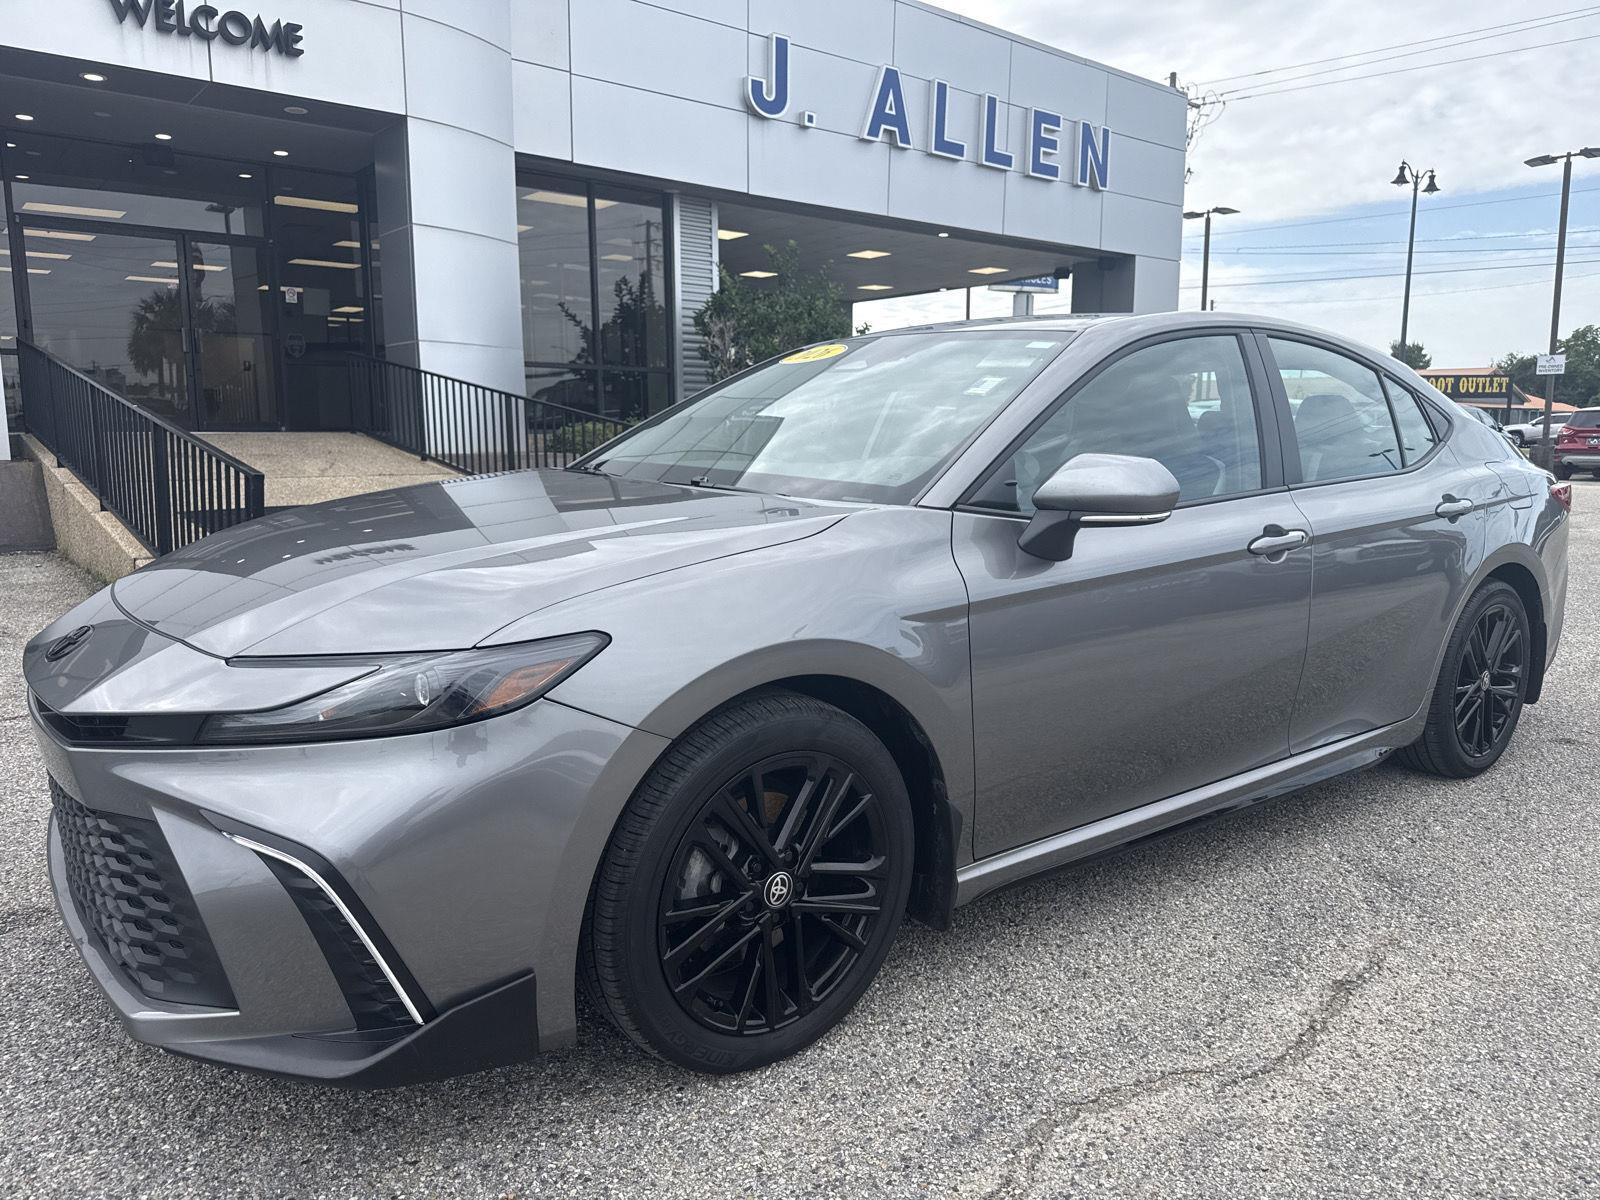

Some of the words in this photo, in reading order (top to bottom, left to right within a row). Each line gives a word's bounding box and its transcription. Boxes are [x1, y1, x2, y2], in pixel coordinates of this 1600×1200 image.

[111, 0, 304, 57] WELCOME
[745, 33, 816, 127] J.
[860, 64, 1112, 191] ALLEN
[1424, 377, 1454, 393] OOT
[1459, 377, 1509, 393] OUTLET
